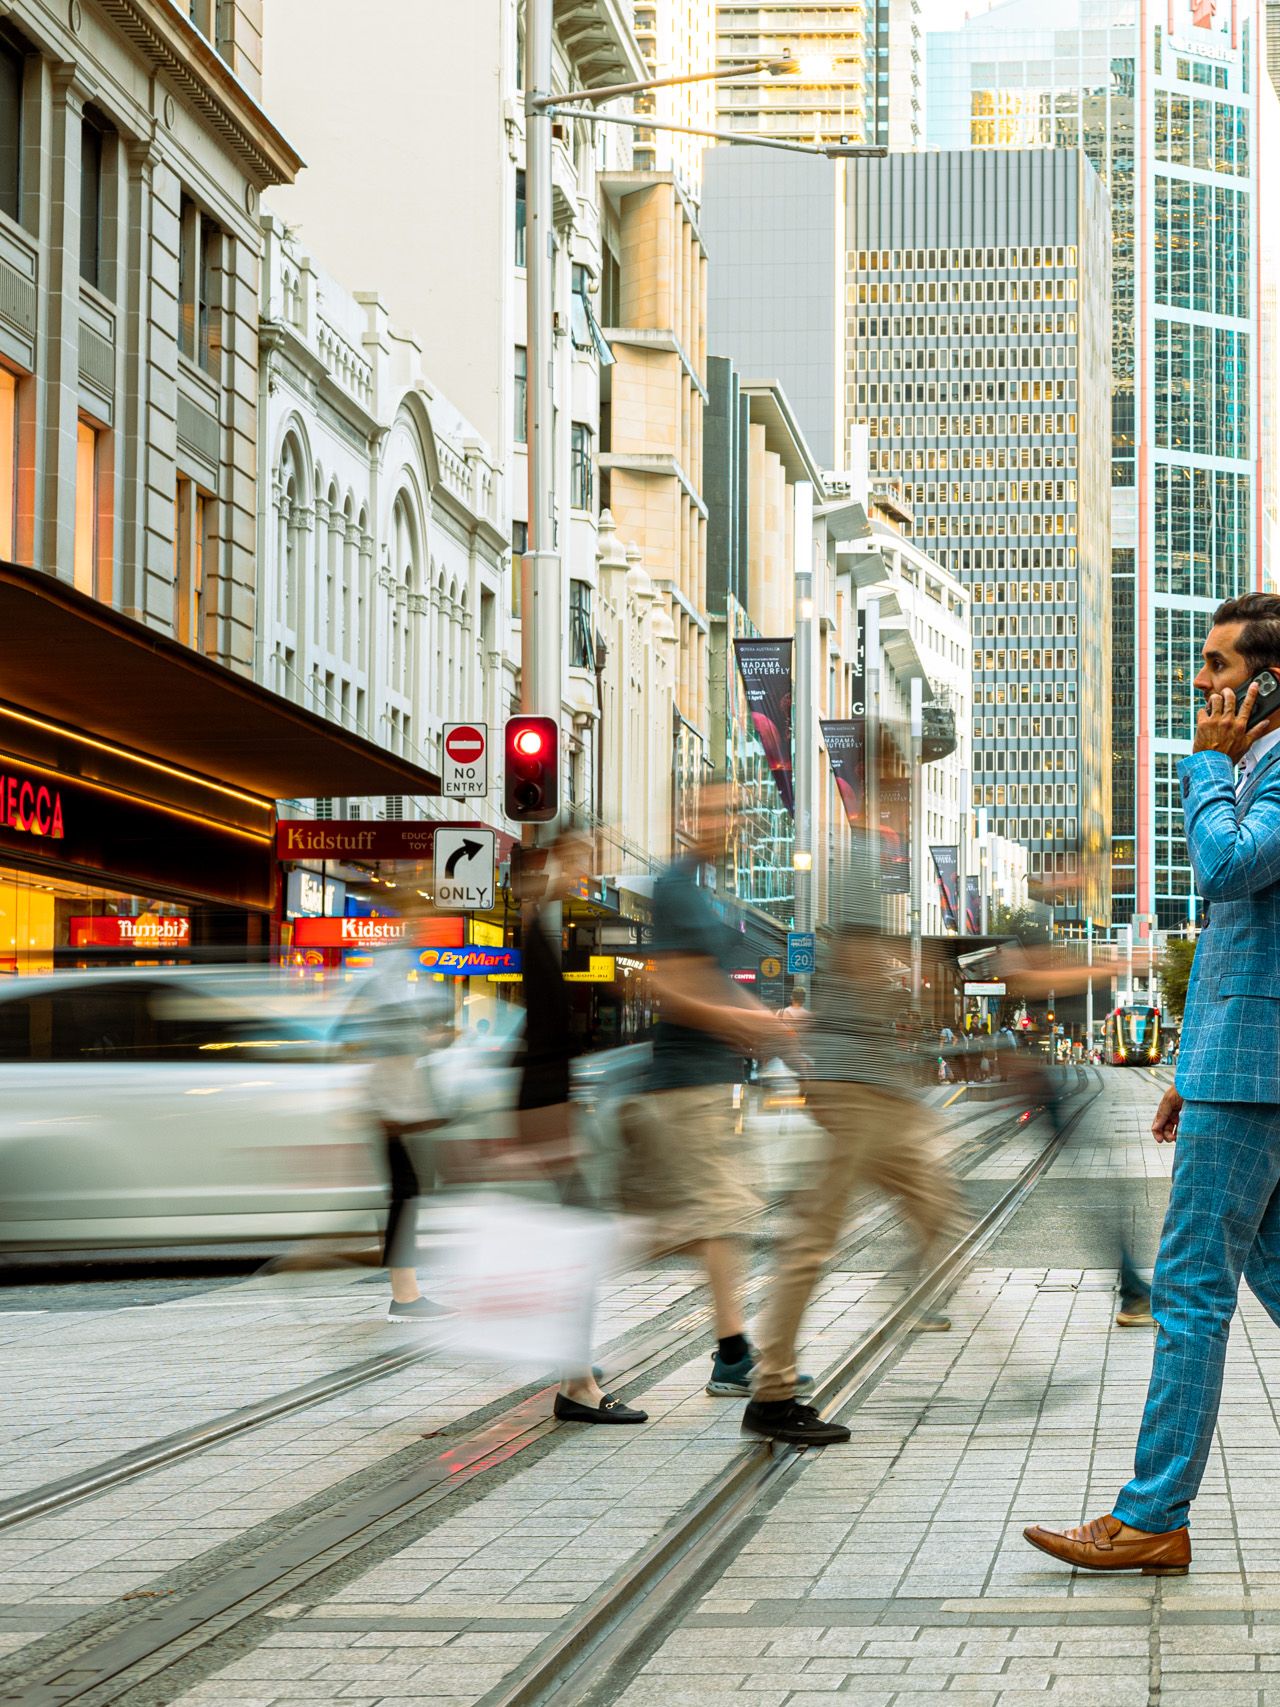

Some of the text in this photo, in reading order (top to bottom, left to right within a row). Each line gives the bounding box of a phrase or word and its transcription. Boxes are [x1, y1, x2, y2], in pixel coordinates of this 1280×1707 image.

[742, 667, 790, 675] BUTTERFLY
[454, 767, 476, 779] NO
[446, 782, 484, 792] ENTRY
[287, 828, 376, 850] Kidstuff
[409, 842, 426, 850] TOY
[439, 886, 488, 901] ONLY
[341, 918, 411, 938] Kidstuf
[438, 949, 510, 969] EzyMart
[795, 954, 808, 967] 20
